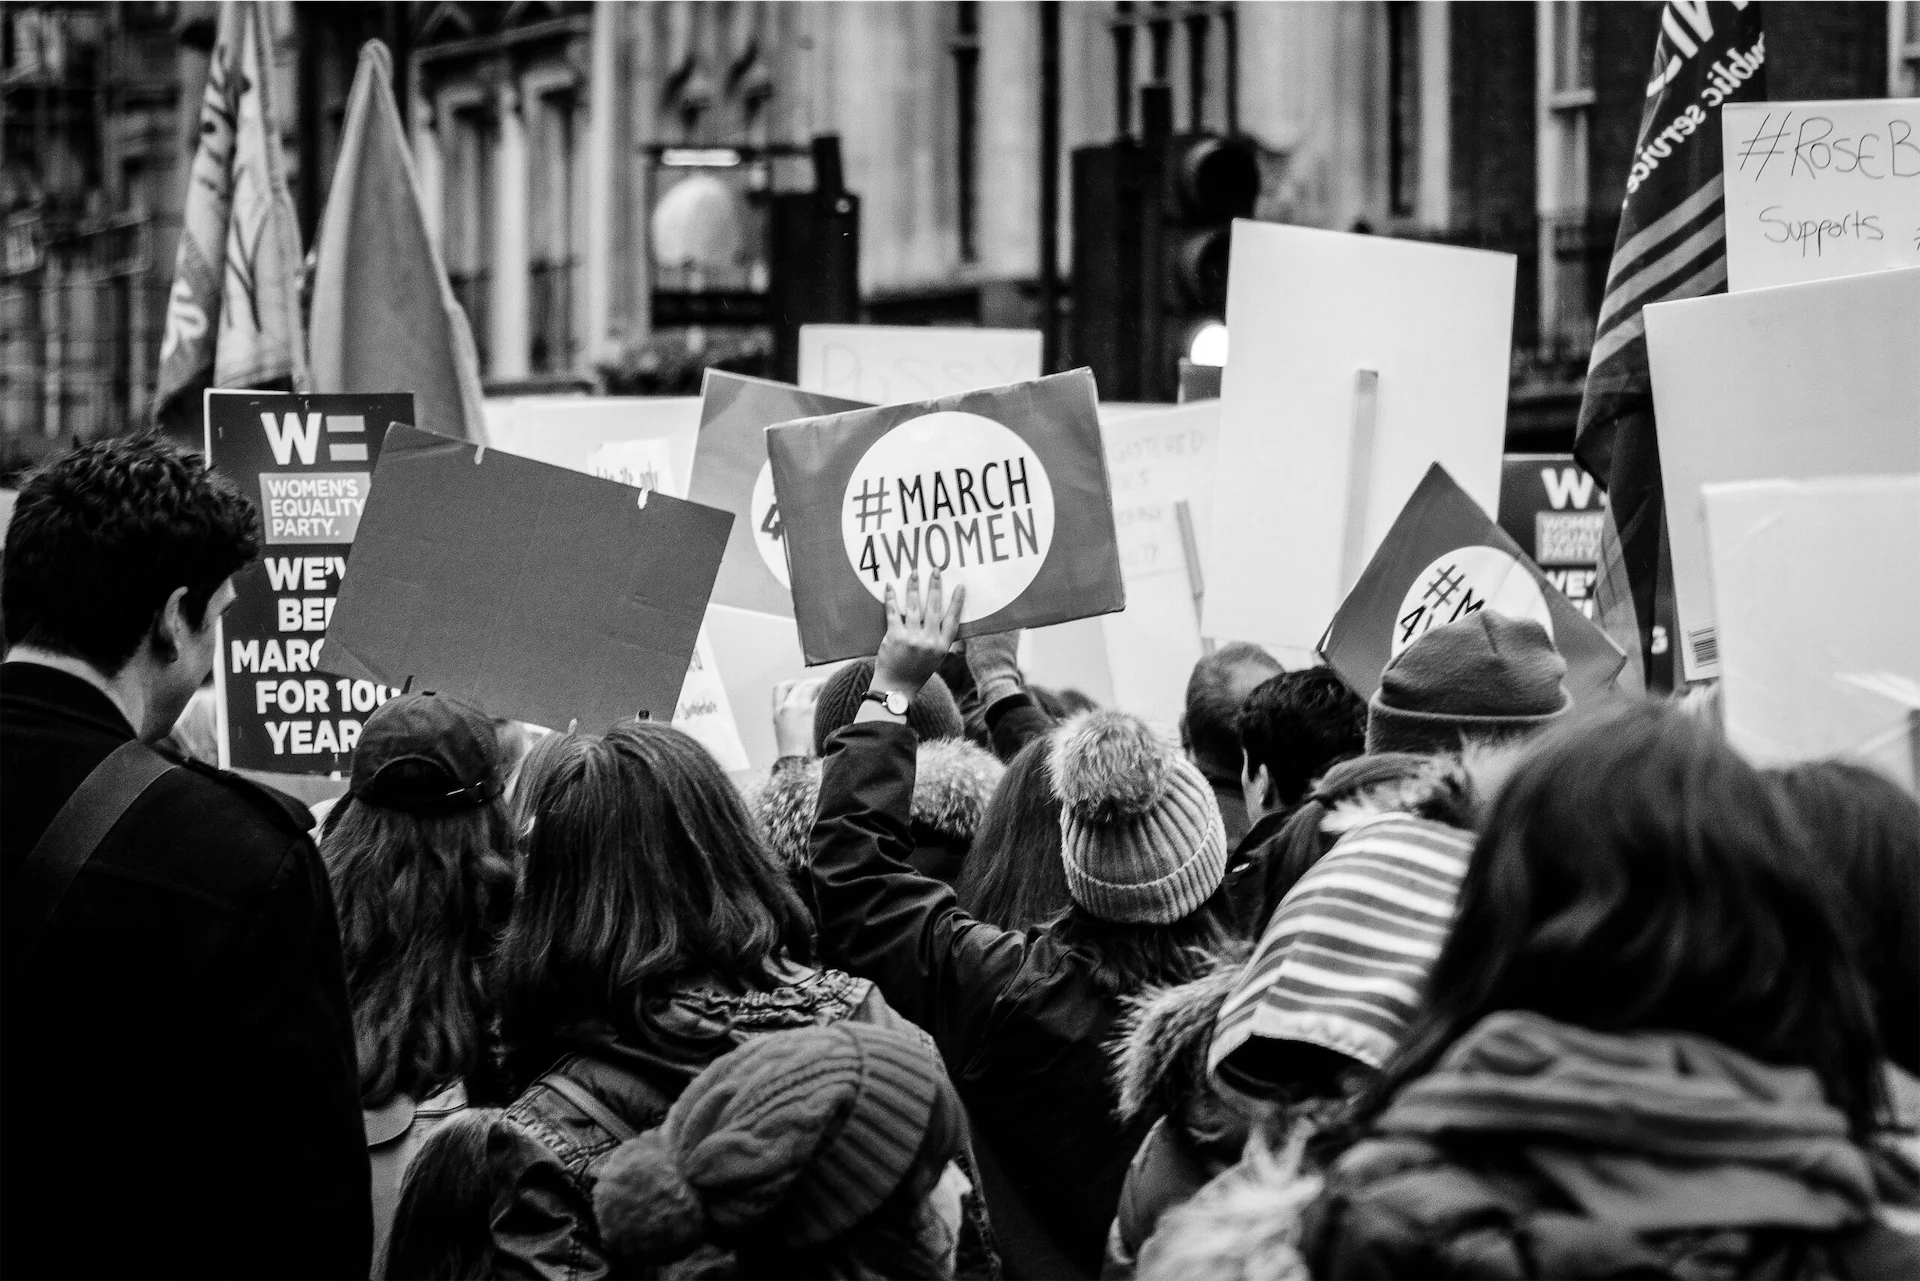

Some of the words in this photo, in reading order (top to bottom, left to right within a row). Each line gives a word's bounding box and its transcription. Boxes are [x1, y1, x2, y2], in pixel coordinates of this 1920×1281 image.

[1759, 206, 1884, 257] Supports
[268, 478, 360, 498] WOMEN'S
[852, 457, 1032, 533] #MARCH
[270, 498, 365, 517] EQUALITY
[272, 518, 340, 537] PARTY.
[859, 508, 1039, 580] 4WOMEN
[256, 680, 330, 714] FOR
